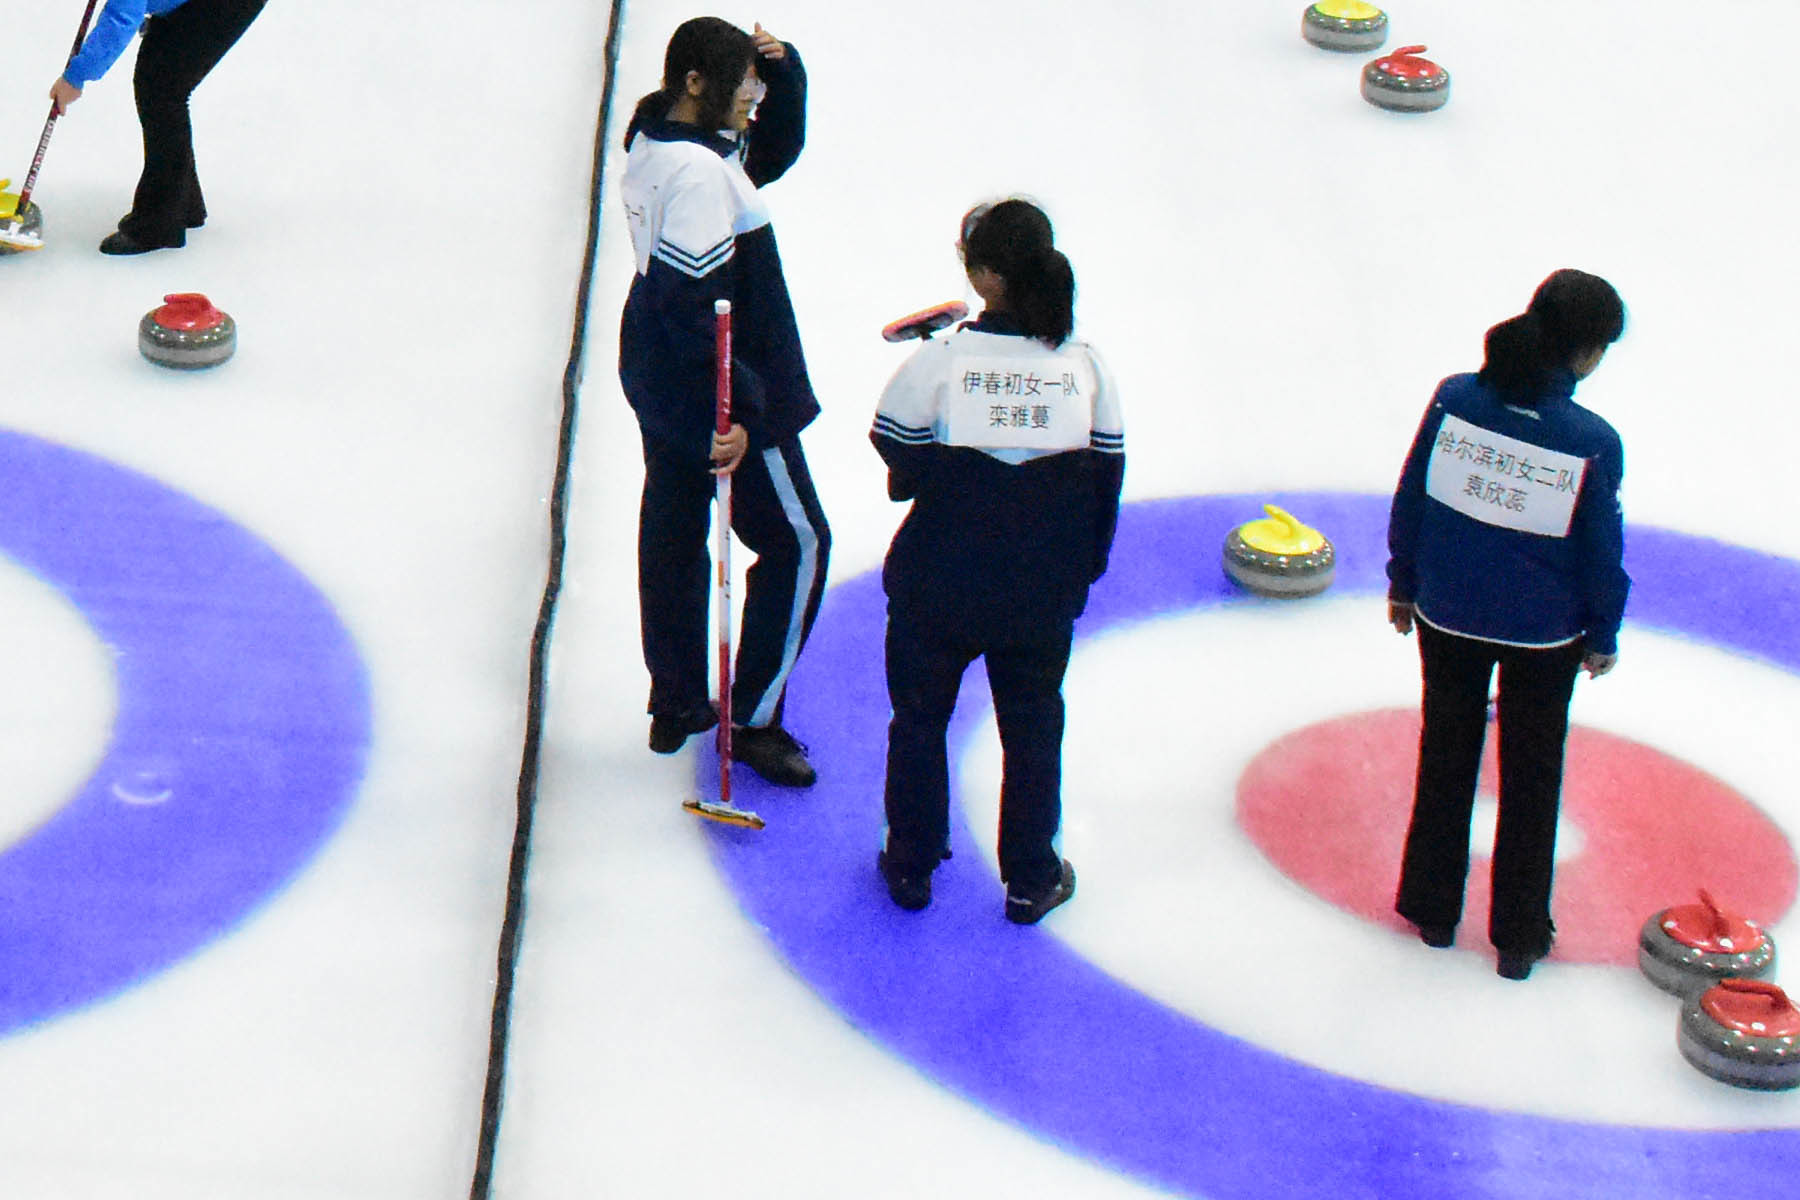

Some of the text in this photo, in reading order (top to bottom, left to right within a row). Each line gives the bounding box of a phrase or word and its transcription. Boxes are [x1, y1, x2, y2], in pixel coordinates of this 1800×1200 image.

[962, 371, 1080, 397] 伊春初女一队
[1437, 430, 1577, 496] 哈尔滨初女二队
